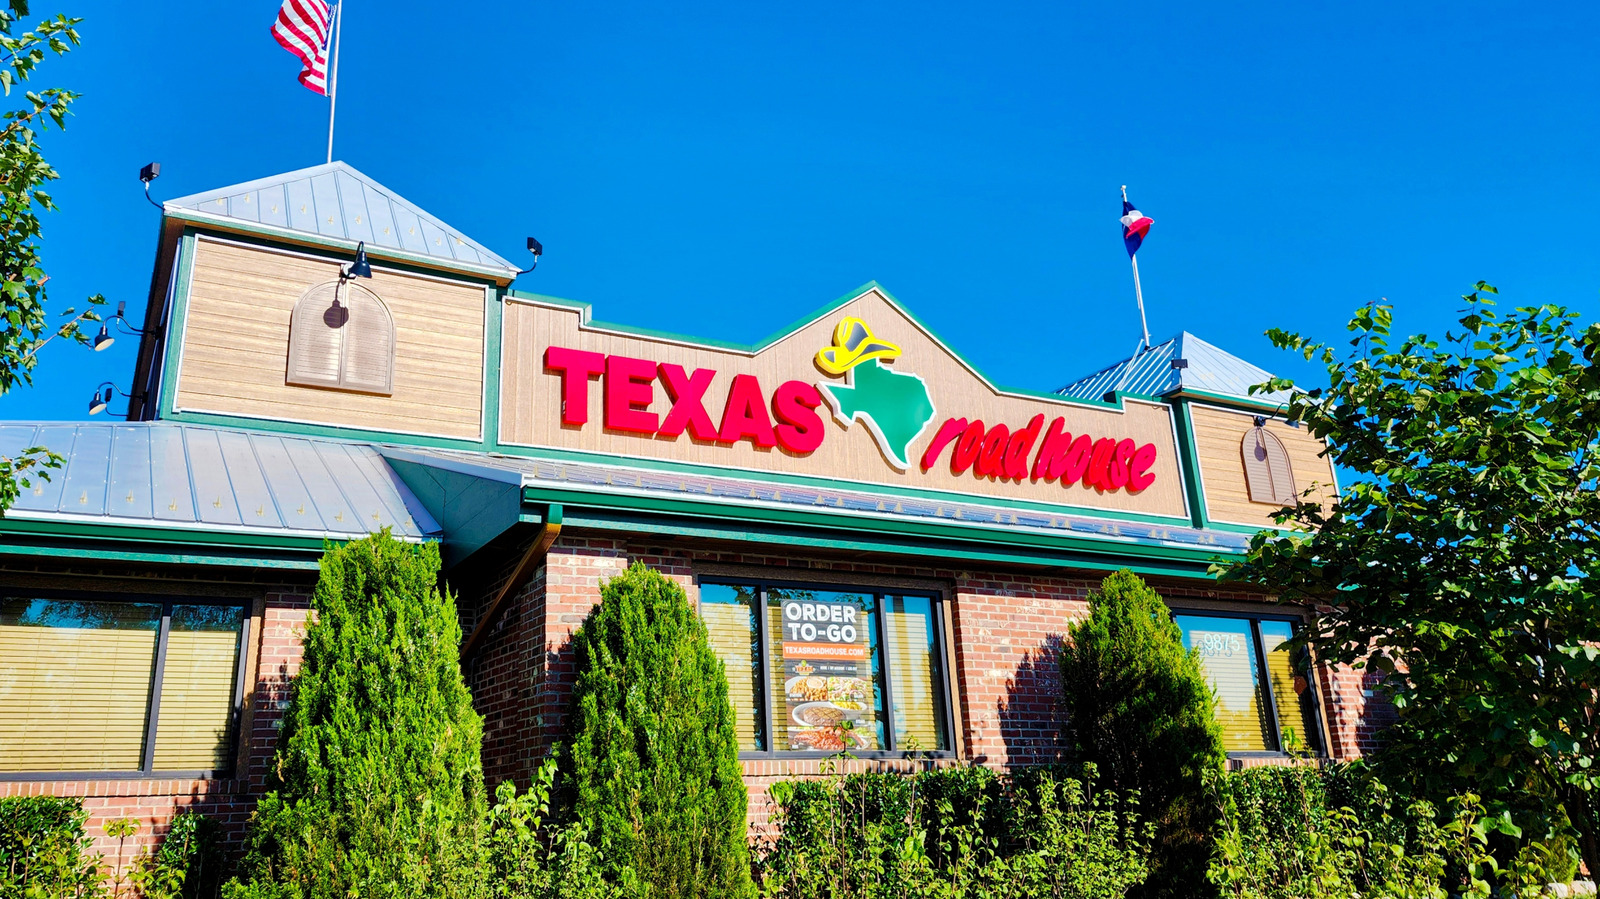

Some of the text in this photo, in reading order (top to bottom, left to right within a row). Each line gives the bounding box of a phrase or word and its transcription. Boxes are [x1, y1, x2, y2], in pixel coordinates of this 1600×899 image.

[544, 346, 1157, 492] TEXAS roadhouse
[785, 603, 857, 622] ORDER
[787, 623, 857, 642] TO-GO
[784, 647, 864, 656] TEXASROADHOUSE.COM
[1204, 634, 1240, 652] 9875
